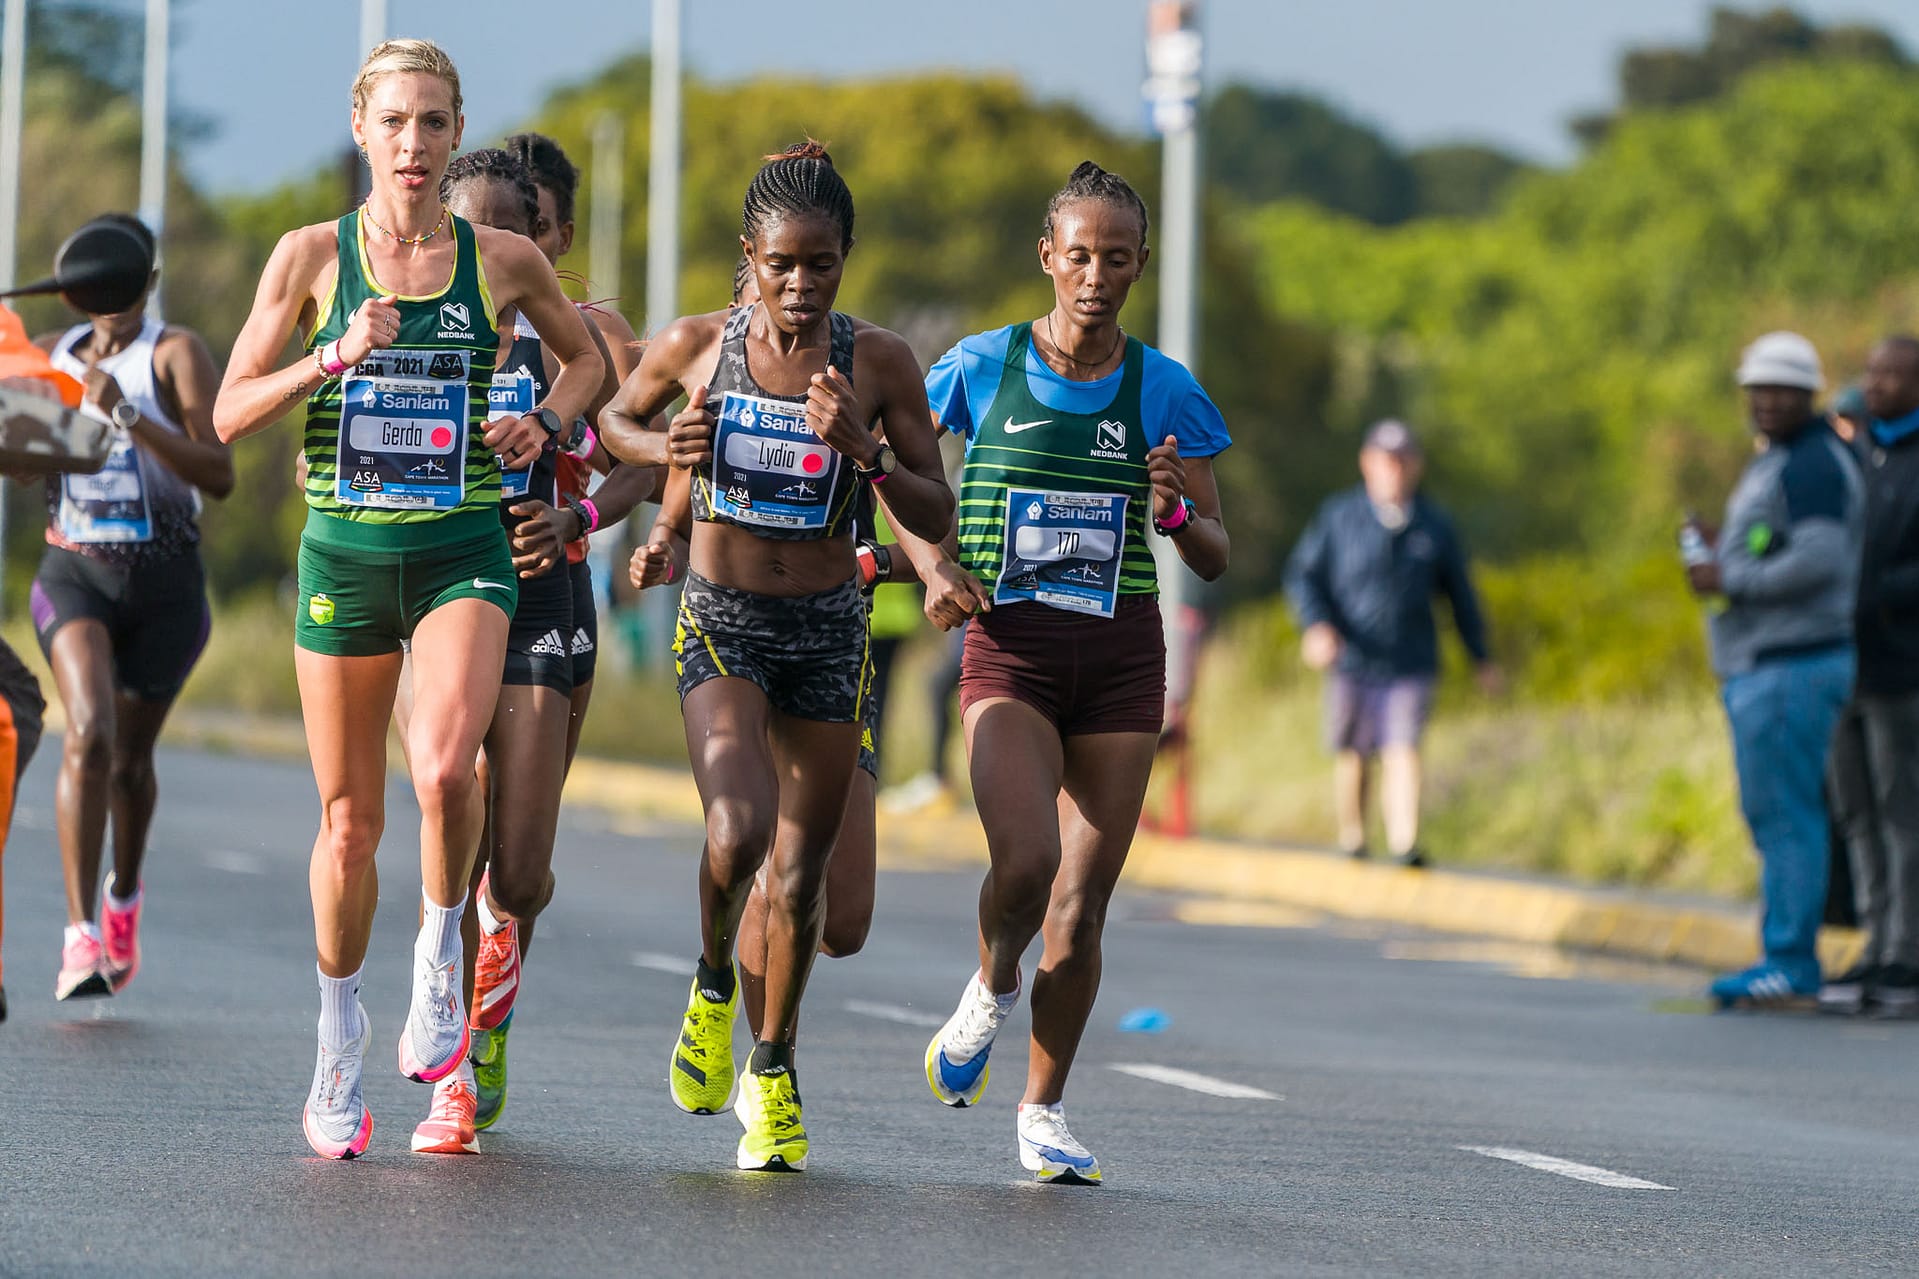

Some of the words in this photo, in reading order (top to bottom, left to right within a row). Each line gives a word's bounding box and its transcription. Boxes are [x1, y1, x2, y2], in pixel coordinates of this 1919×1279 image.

[437, 331, 475, 341] NEDBANK
[394, 357, 424, 375] 2021
[432, 356, 461, 369] ASA
[382, 394, 449, 410] Sanlam
[759, 413, 816, 435] Sanla
[382, 421, 422, 447] Gerda
[360, 456, 374, 465] 2021
[758, 441, 795, 470] Lydia
[1090, 449, 1128, 461] NEDBANK
[353, 470, 381, 484] ASA
[733, 472, 747, 482] 2021
[728, 485, 750, 501] ASA
[1047, 505, 1112, 521] Sanlam
[1057, 531, 1080, 556] 170
[531, 644, 565, 658] adidas
